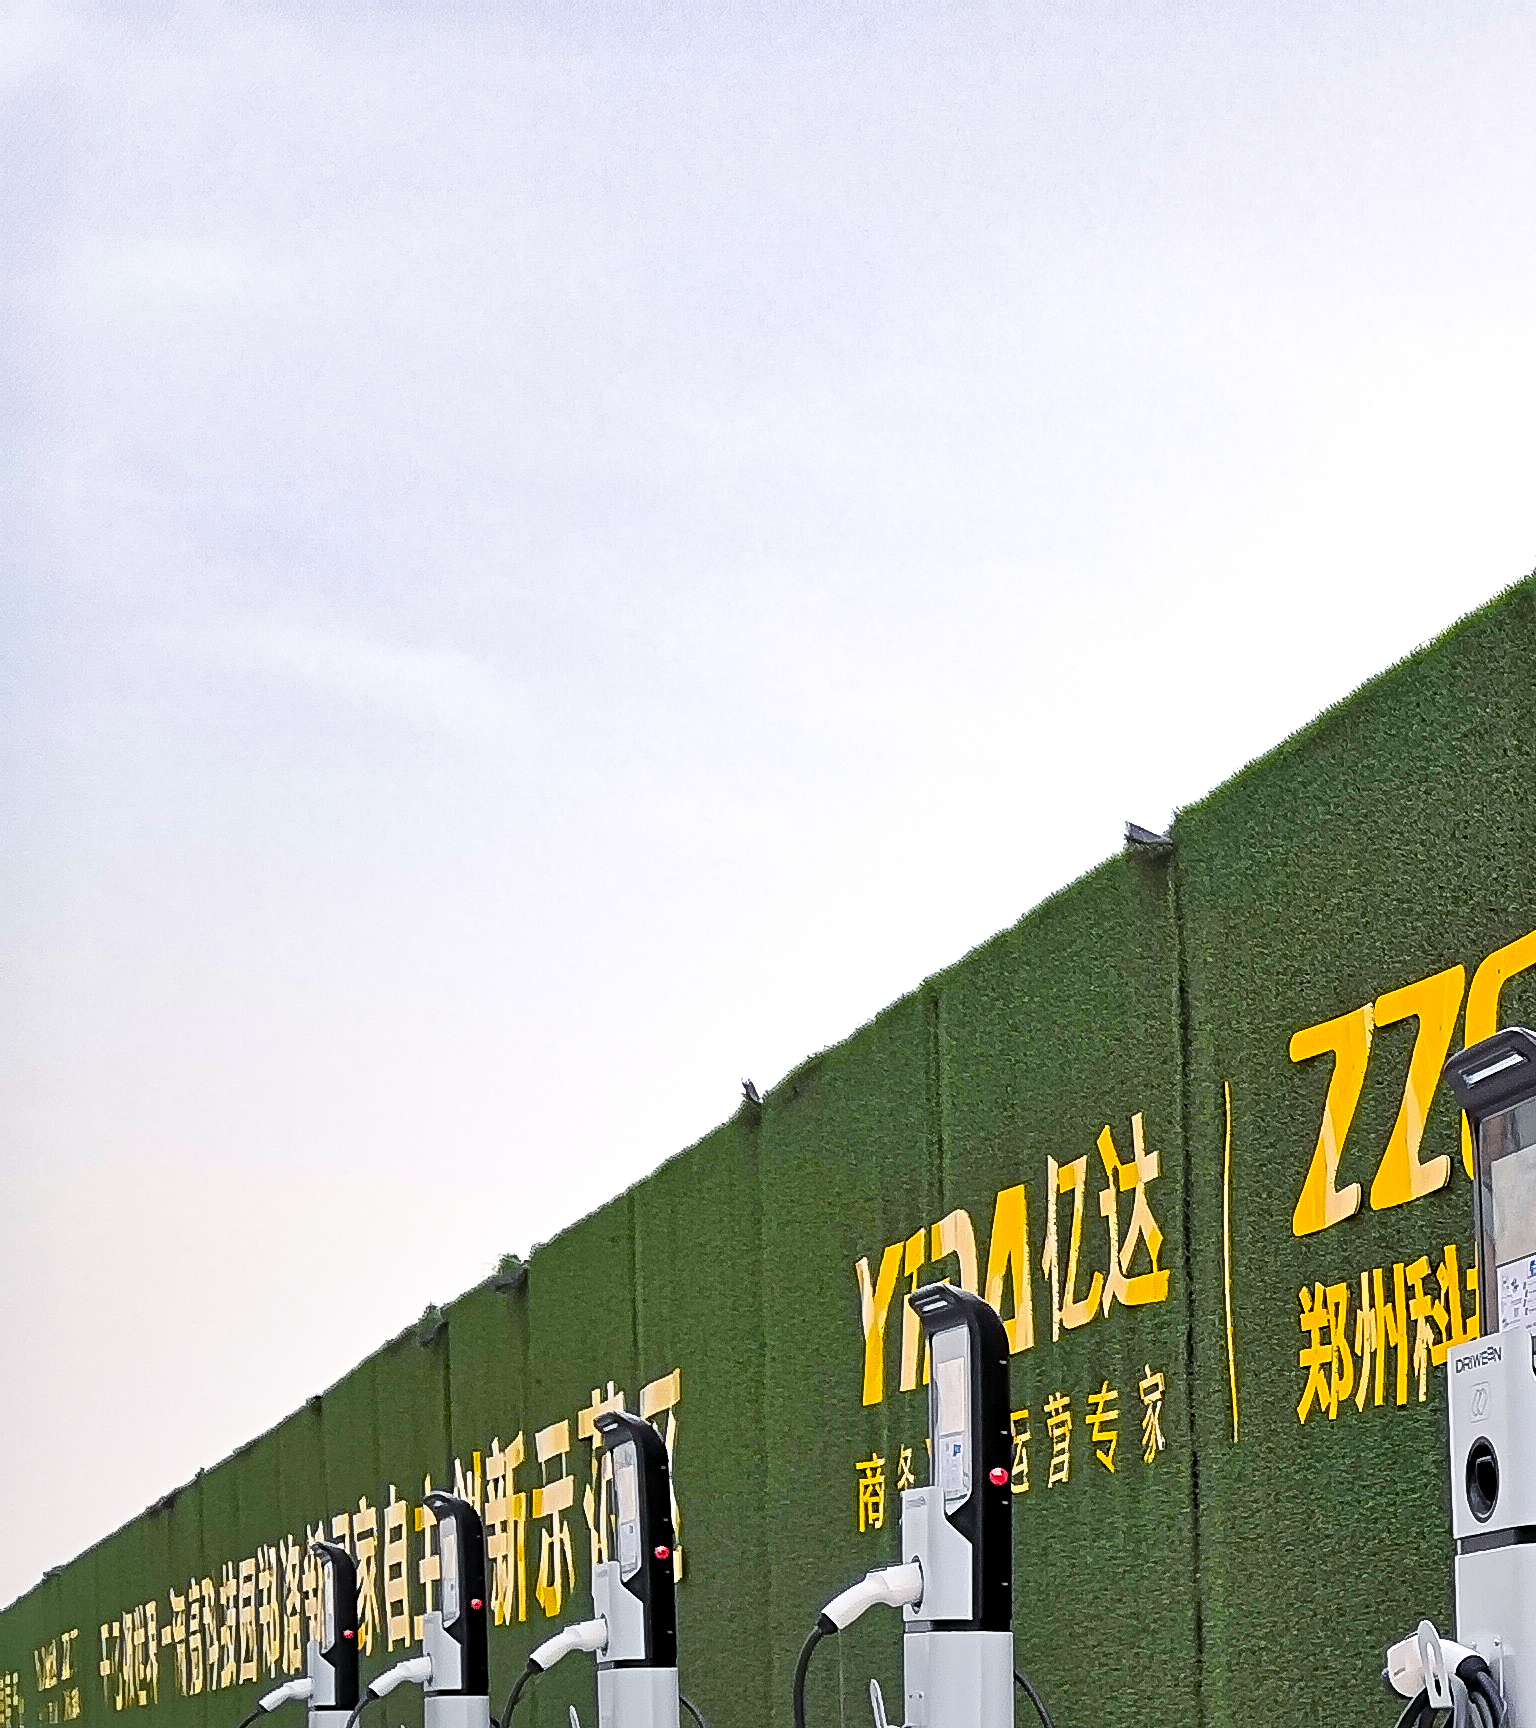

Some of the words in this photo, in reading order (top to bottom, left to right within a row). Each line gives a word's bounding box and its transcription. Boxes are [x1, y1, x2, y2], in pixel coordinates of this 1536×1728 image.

[854, 1364, 1167, 1533] 商务运营专家
